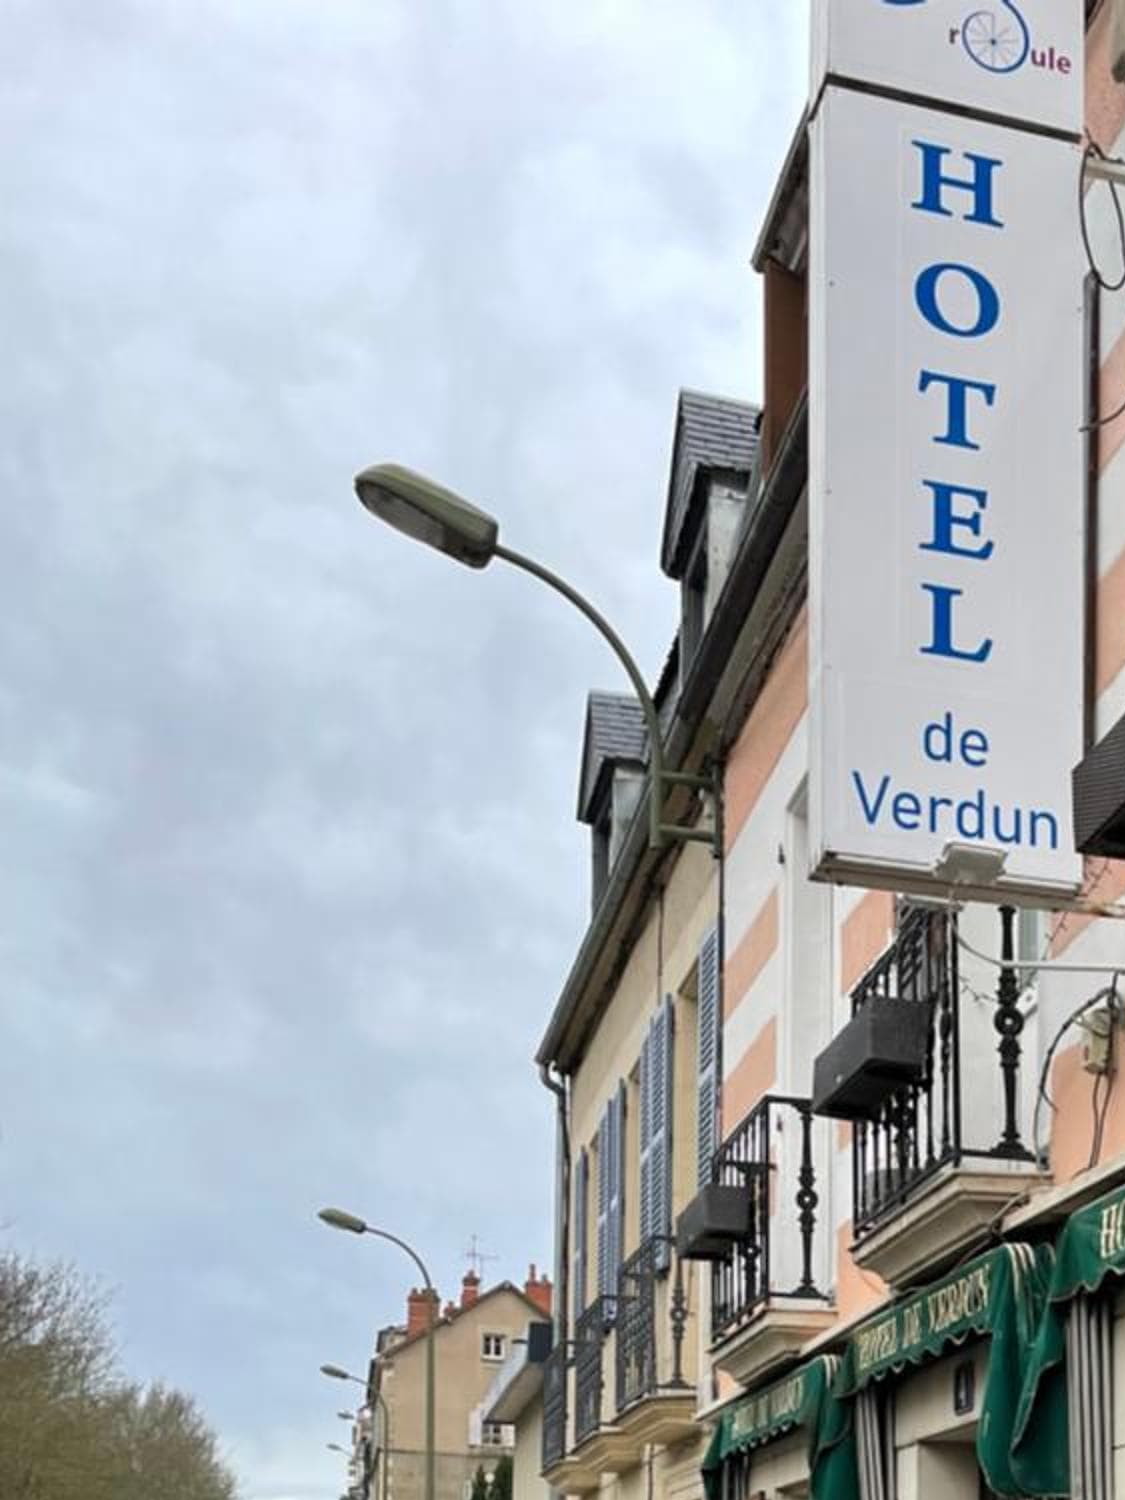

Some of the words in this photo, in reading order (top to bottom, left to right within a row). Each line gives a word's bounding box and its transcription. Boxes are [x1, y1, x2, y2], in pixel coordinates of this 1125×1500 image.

[911, 139, 1004, 663] HOTEL
[923, 711, 990, 768] de
[852, 769, 1058, 850] Verdun
